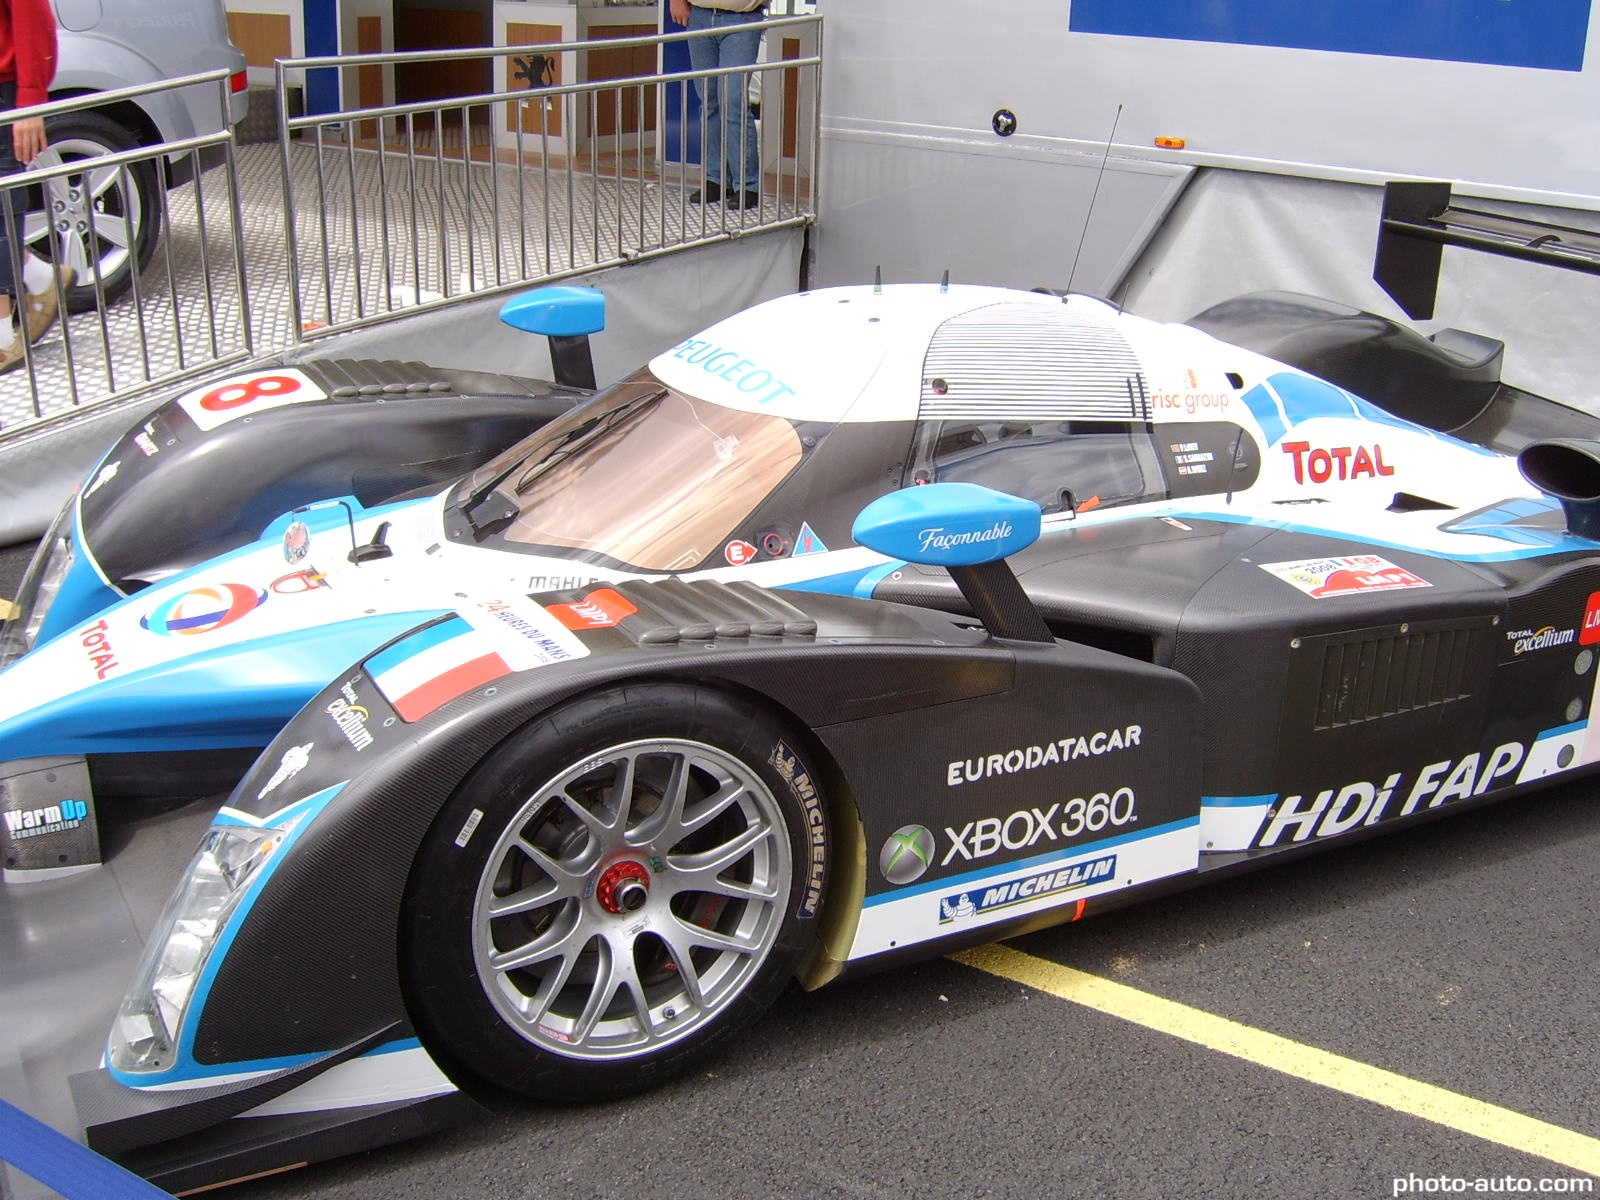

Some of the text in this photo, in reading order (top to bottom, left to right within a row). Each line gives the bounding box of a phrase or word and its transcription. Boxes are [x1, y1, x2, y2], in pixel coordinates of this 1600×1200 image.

[200, 375, 302, 412] 8
[1151, 388, 1229, 415] risc group
[1281, 440, 1395, 486] TOTAL
[918, 520, 1013, 553] Façonnable
[80, 619, 119, 680] TOTAL
[1506, 629, 1534, 641] TOTAL
[1514, 628, 1575, 654] excellium
[340, 681, 359, 706] TOTAL
[327, 698, 375, 752] excellium
[947, 725, 1142, 786] EURODATACAR
[1259, 742, 1524, 847] HDi FAP
[794, 771, 825, 914] MICHELIN
[941, 803, 1060, 867] XBOX
[1061, 787, 1135, 837] 360
[981, 857, 1114, 908] MICHELIN
